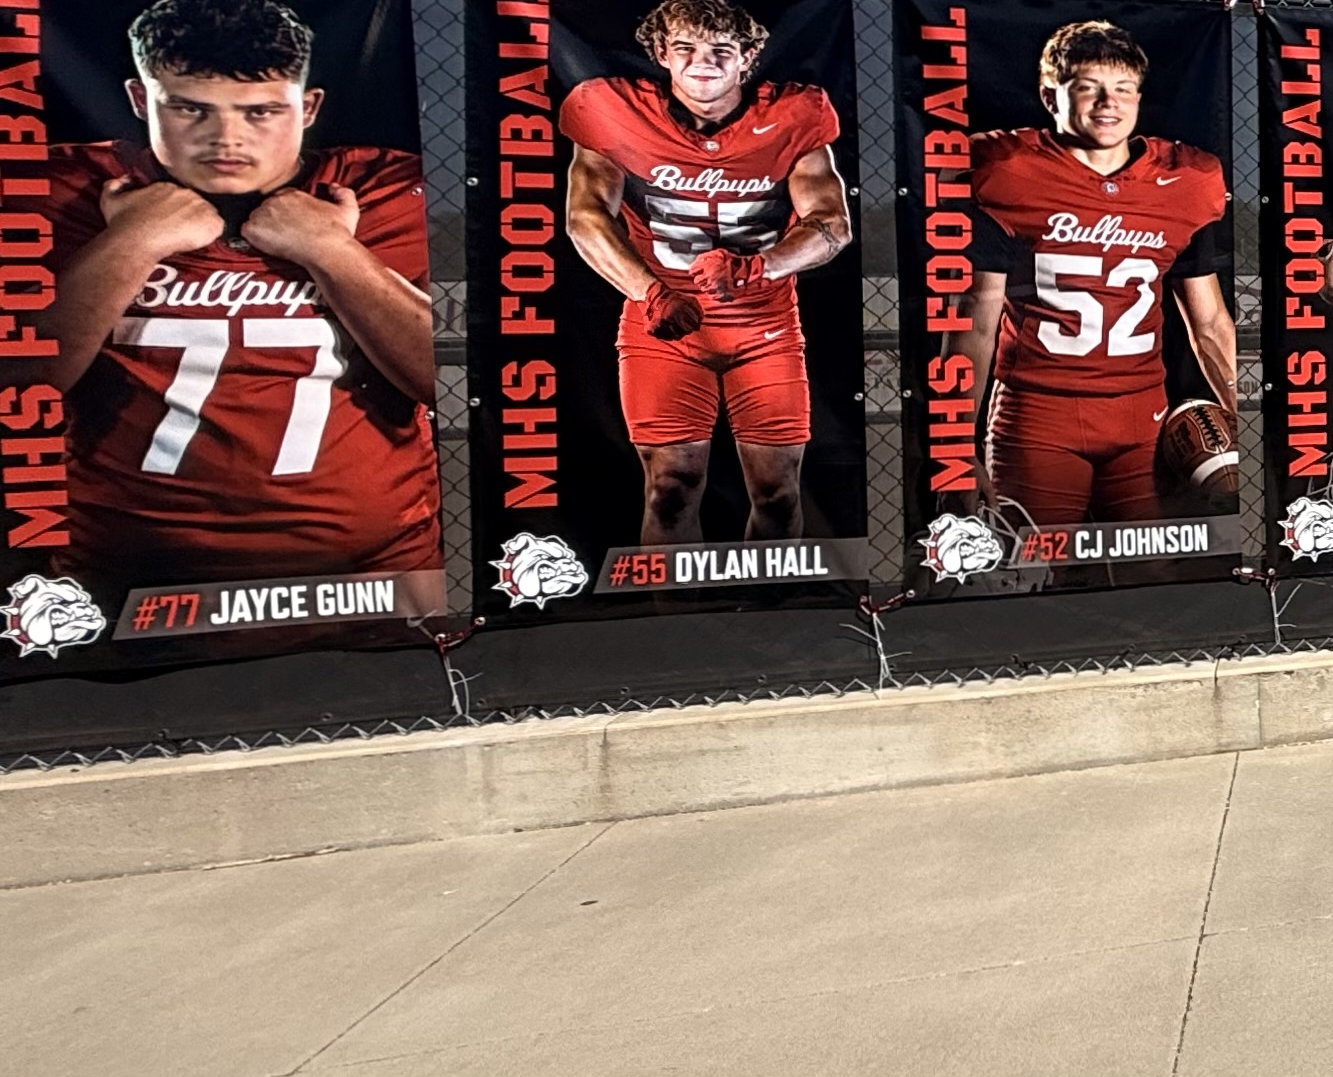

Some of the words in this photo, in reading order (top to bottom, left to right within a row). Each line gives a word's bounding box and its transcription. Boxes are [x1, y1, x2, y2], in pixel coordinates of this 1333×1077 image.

[647, 165, 775, 198] Bullpups
[920, 7, 974, 333] FOOTBALL
[1281, 28, 1325, 329] FOOTBALL
[645, 195, 778, 271] 55
[1042, 212, 1167, 251] Bullpups
[134, 265, 321, 317] Bullpup
[1034, 253, 1160, 357] 52
[114, 316, 350, 477] 77
[503, 360, 558, 509] MHS
[928, 355, 976, 493] MHS
[1286, 350, 1328, 476] MHS
[1, 379, 71, 548] MHS
[610, 554, 666, 586] #55
[675, 551, 759, 584] DYLAN
[765, 544, 829, 579] HALL
[1021, 530, 1068, 561] #52
[1075, 530, 1103, 559] CJ
[1107, 524, 1208, 557] JOHNSON
[133, 594, 201, 631] #77
[210, 586, 310, 626] JAYCE
[316, 579, 395, 615] GUNN
